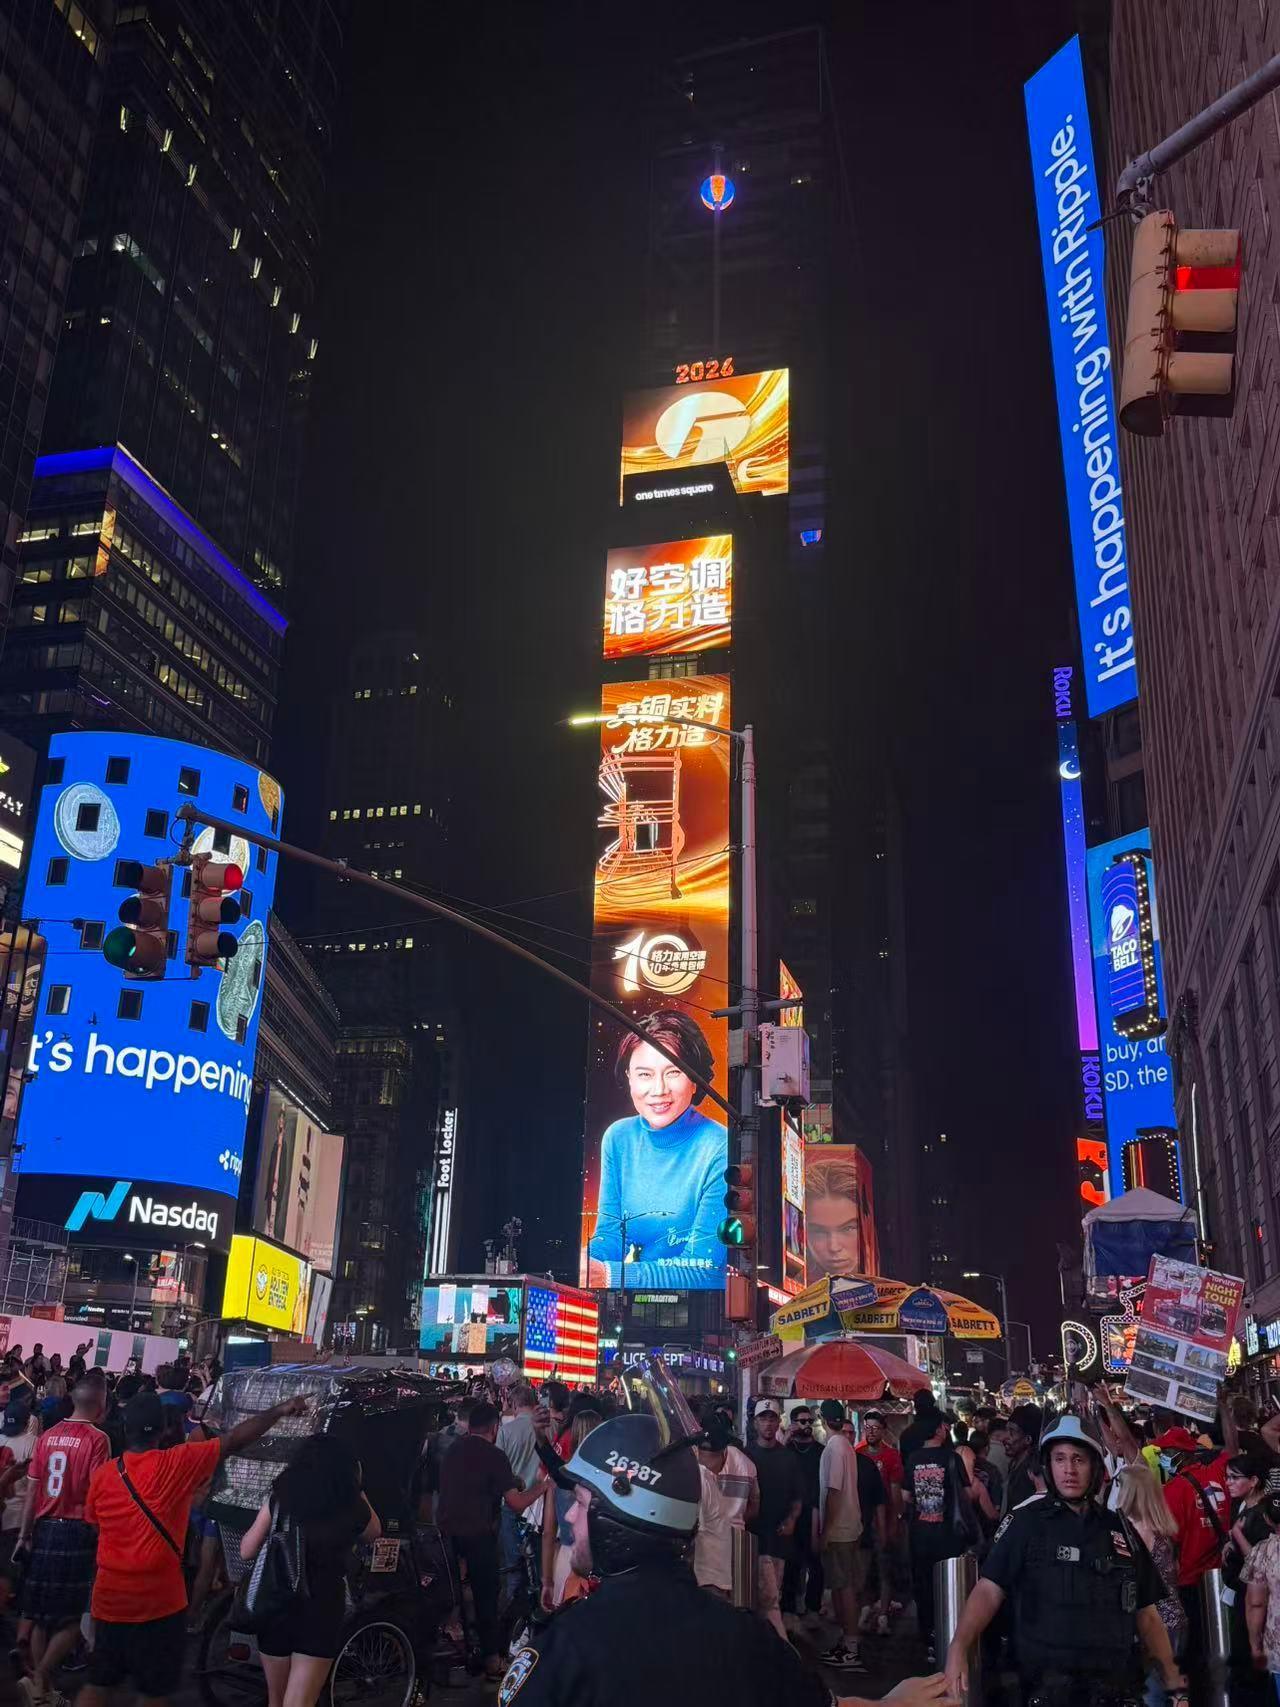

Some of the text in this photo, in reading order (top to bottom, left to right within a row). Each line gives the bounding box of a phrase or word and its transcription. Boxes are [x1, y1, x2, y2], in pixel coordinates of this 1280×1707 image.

[675, 357, 735, 383] 2026
[1045, 113, 1136, 684] It's happening with Ripple.
[635, 483, 714, 501] one times square
[610, 556, 727, 600] 好空调
[608, 592, 730, 636] 格力造
[1053, 666, 1073, 717] ROKU
[611, 724, 720, 754] 格力造
[1110, 939, 1138, 960] TACO
[1113, 954, 1139, 973] BELL
[1137, 1064, 1168, 1085] the
[437, 1110, 454, 1188] Foot Locker
[128, 1196, 219, 1239] Nasdaq
[1204, 1291, 1236, 1307] TOUR
[1205, 1281, 1240, 1298] NIGHT
[778, 1301, 828, 1326] SABRETT
[853, 1312, 896, 1325] SABRETT
[952, 1318, 996, 1331] SABRETT
[612, 1352, 646, 1365] LICE
[663, 1353, 685, 1366] EPT
[47, 1450, 67, 1498] 8
[604, 1450, 662, 1486] 26387
